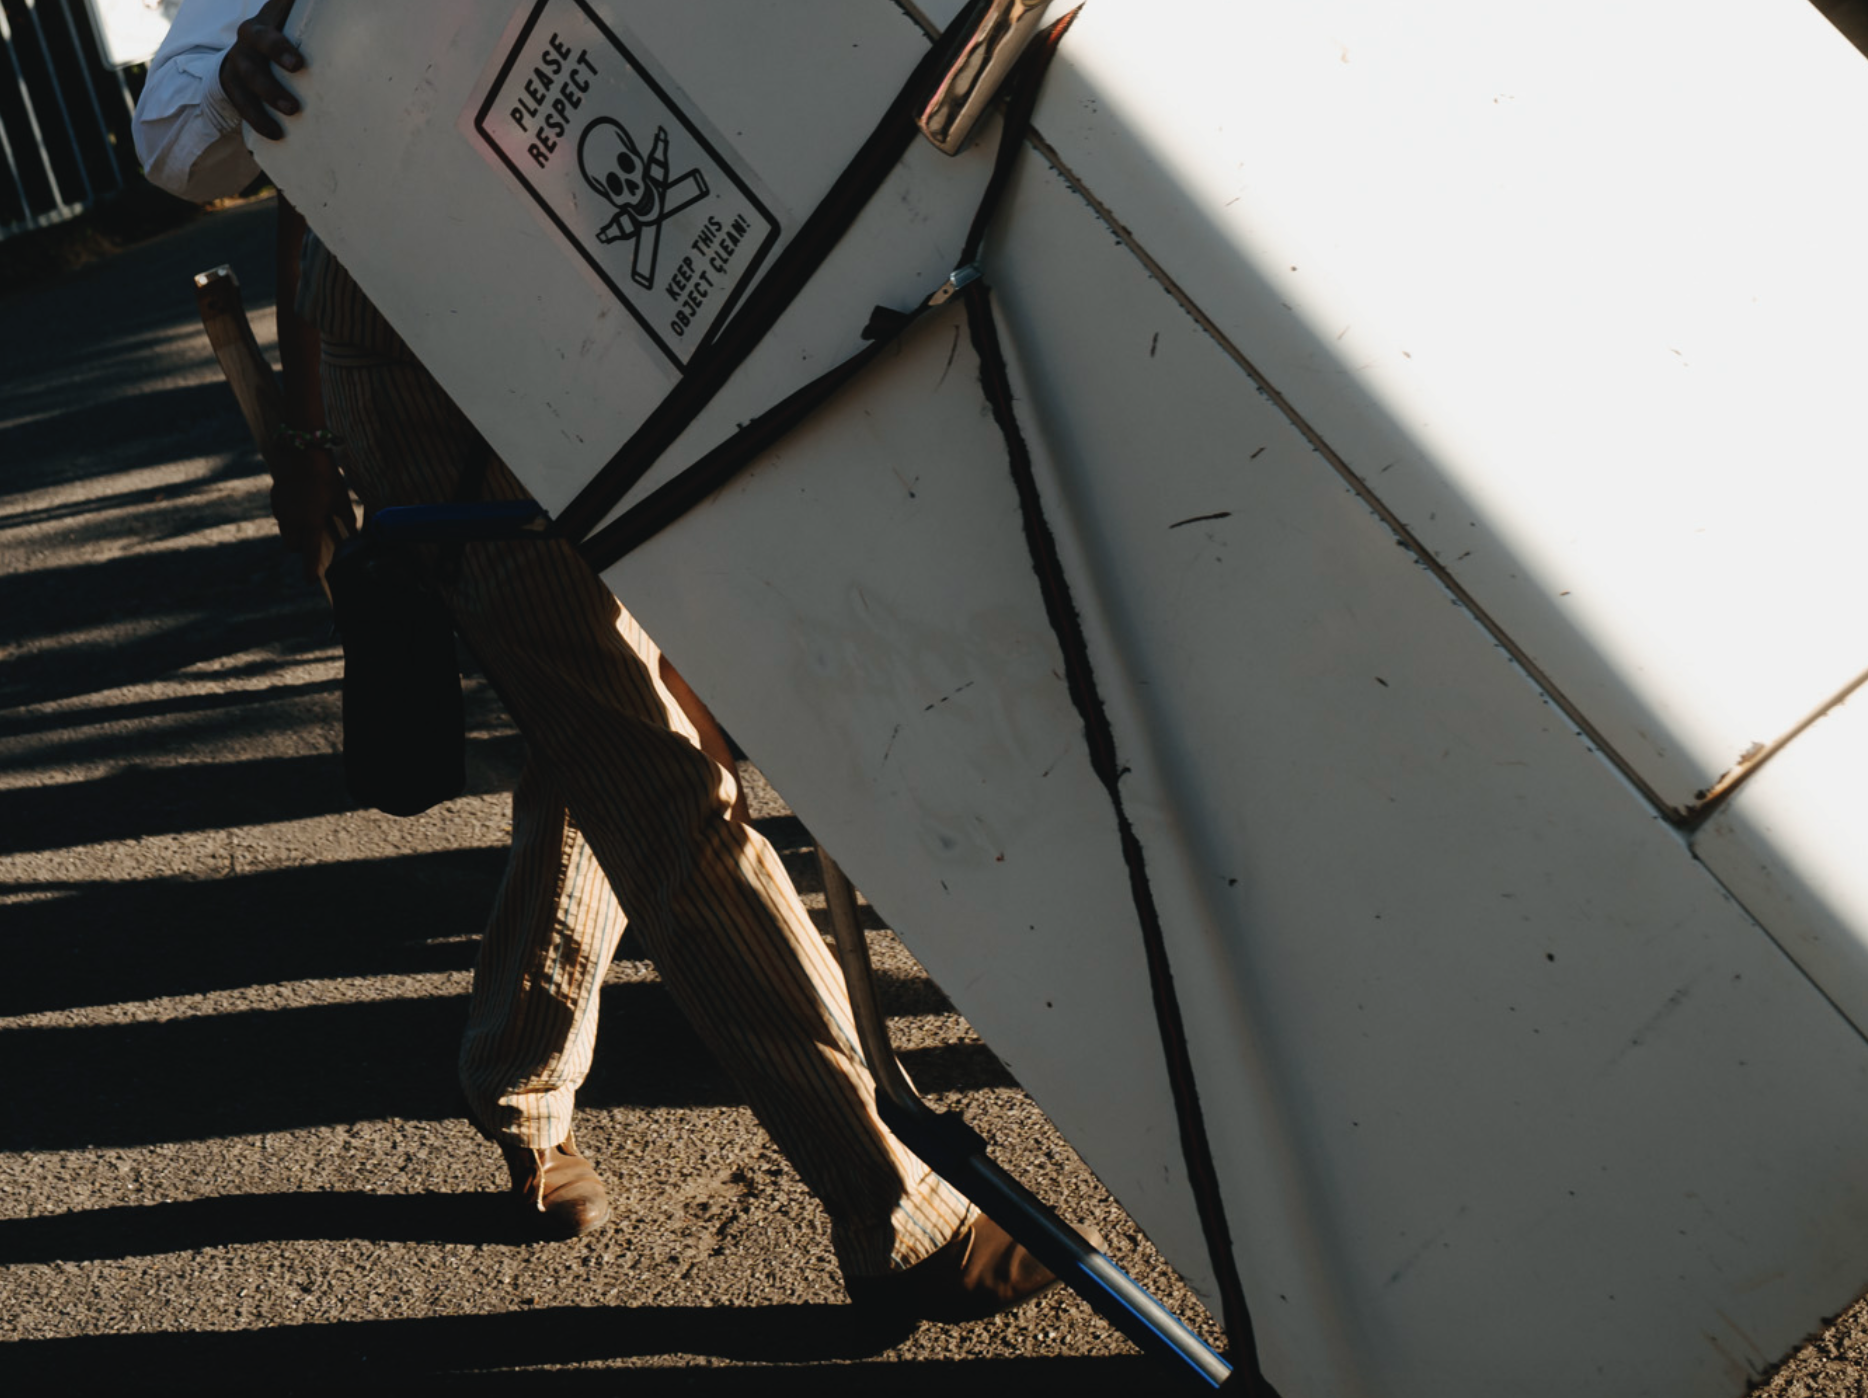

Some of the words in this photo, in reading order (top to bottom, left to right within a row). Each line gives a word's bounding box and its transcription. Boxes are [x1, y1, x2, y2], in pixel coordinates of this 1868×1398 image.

[510, 32, 572, 133] PLEASE
[527, 49, 598, 169] RESPECT
[665, 256, 695, 302] KEEP
[691, 215, 722, 257] THIS
[671, 270, 714, 337] OBJECT
[709, 213, 751, 274] CLEAN!
